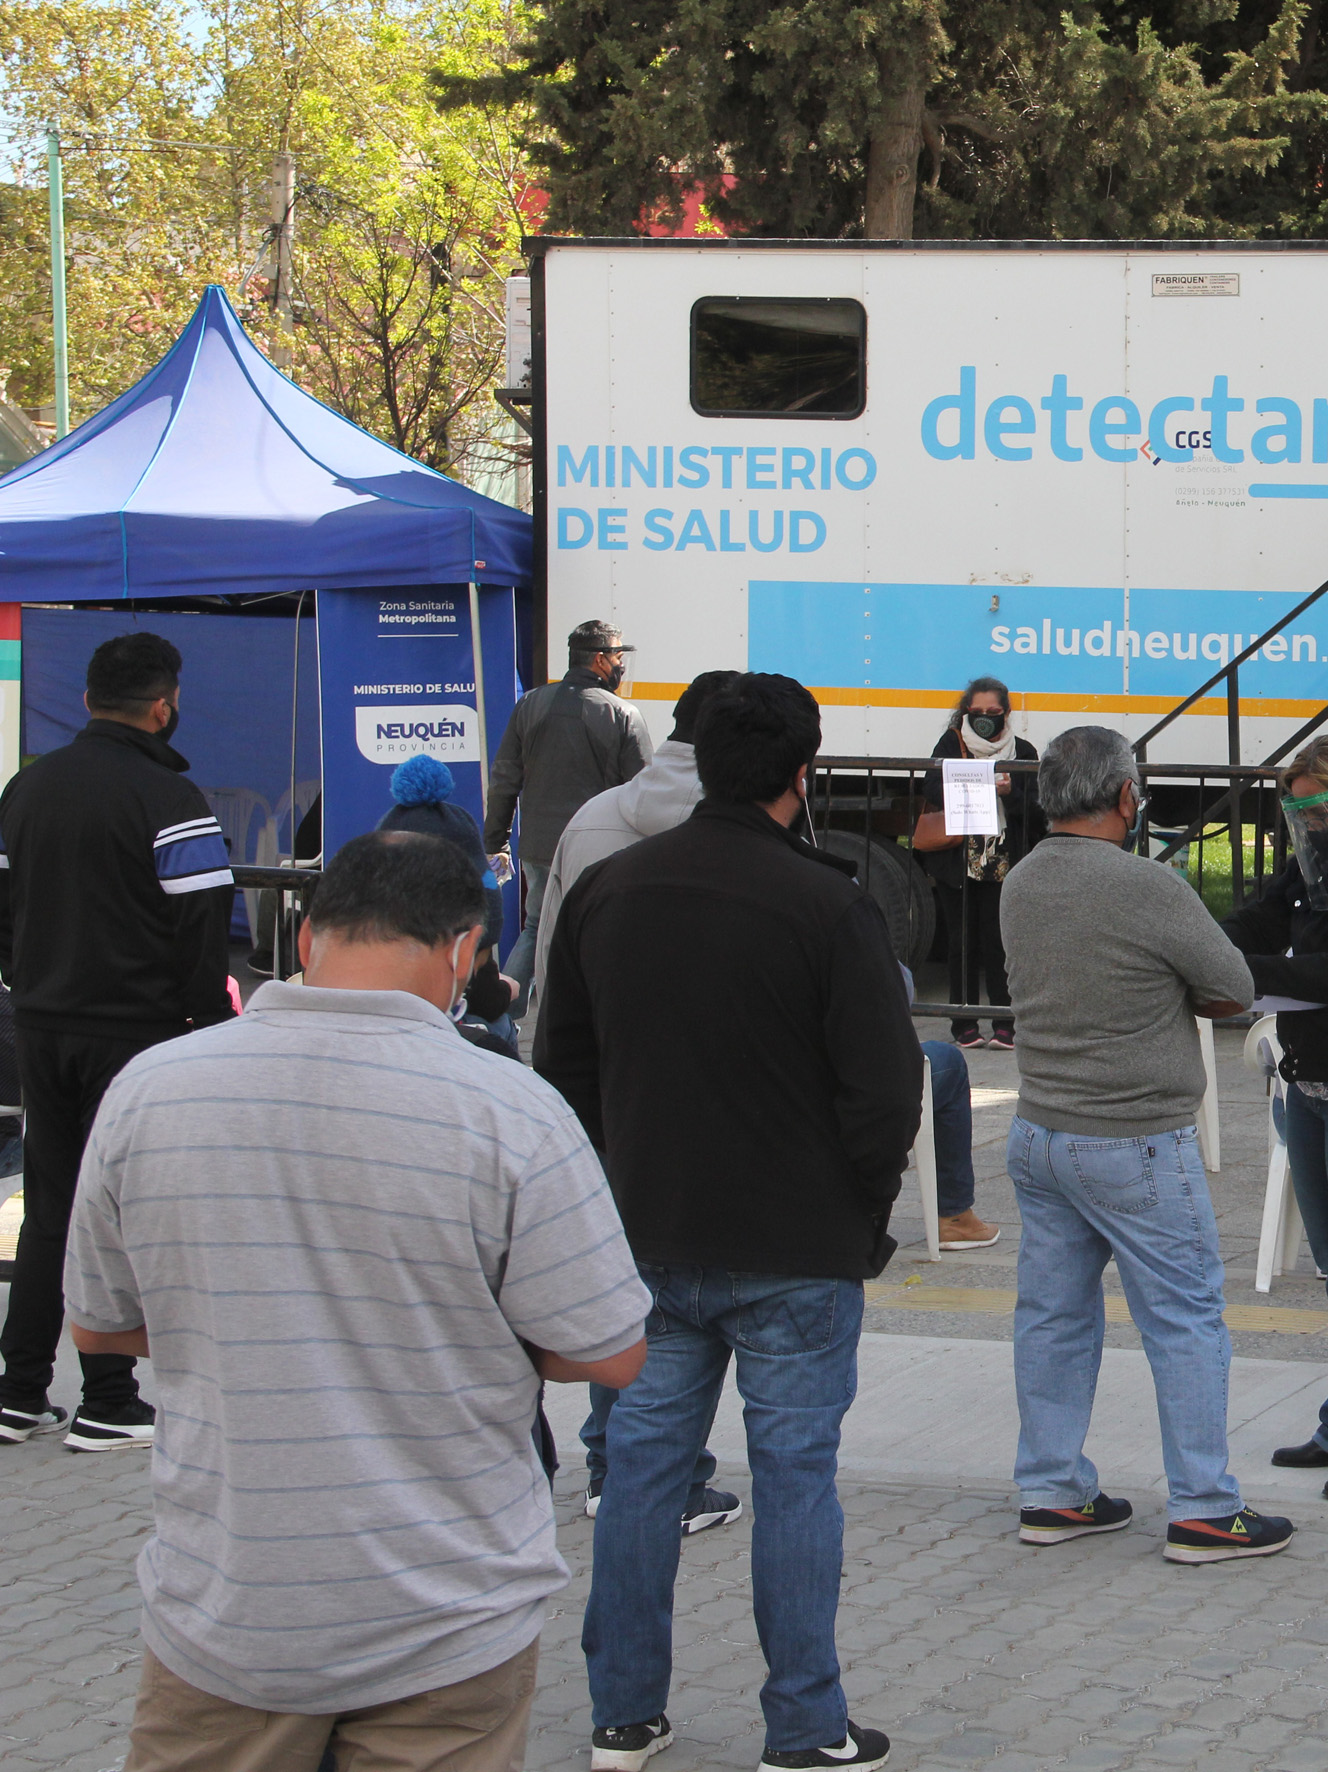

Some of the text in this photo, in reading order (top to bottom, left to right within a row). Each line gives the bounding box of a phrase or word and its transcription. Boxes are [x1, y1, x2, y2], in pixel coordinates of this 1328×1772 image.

[1155, 276, 1204, 284] FABRIQUEN
[556, 444, 878, 492] MINISTERIO
[556, 508, 828, 553] DE SALUD
[379, 601, 454, 610] Zona Sanitaria
[378, 614, 456, 625] Metropolitana
[354, 683, 475, 695] MINISTERIO DE SALU
[376, 718, 465, 741] NEUQUÉN
[377, 742, 466, 752] PROVINCIA
